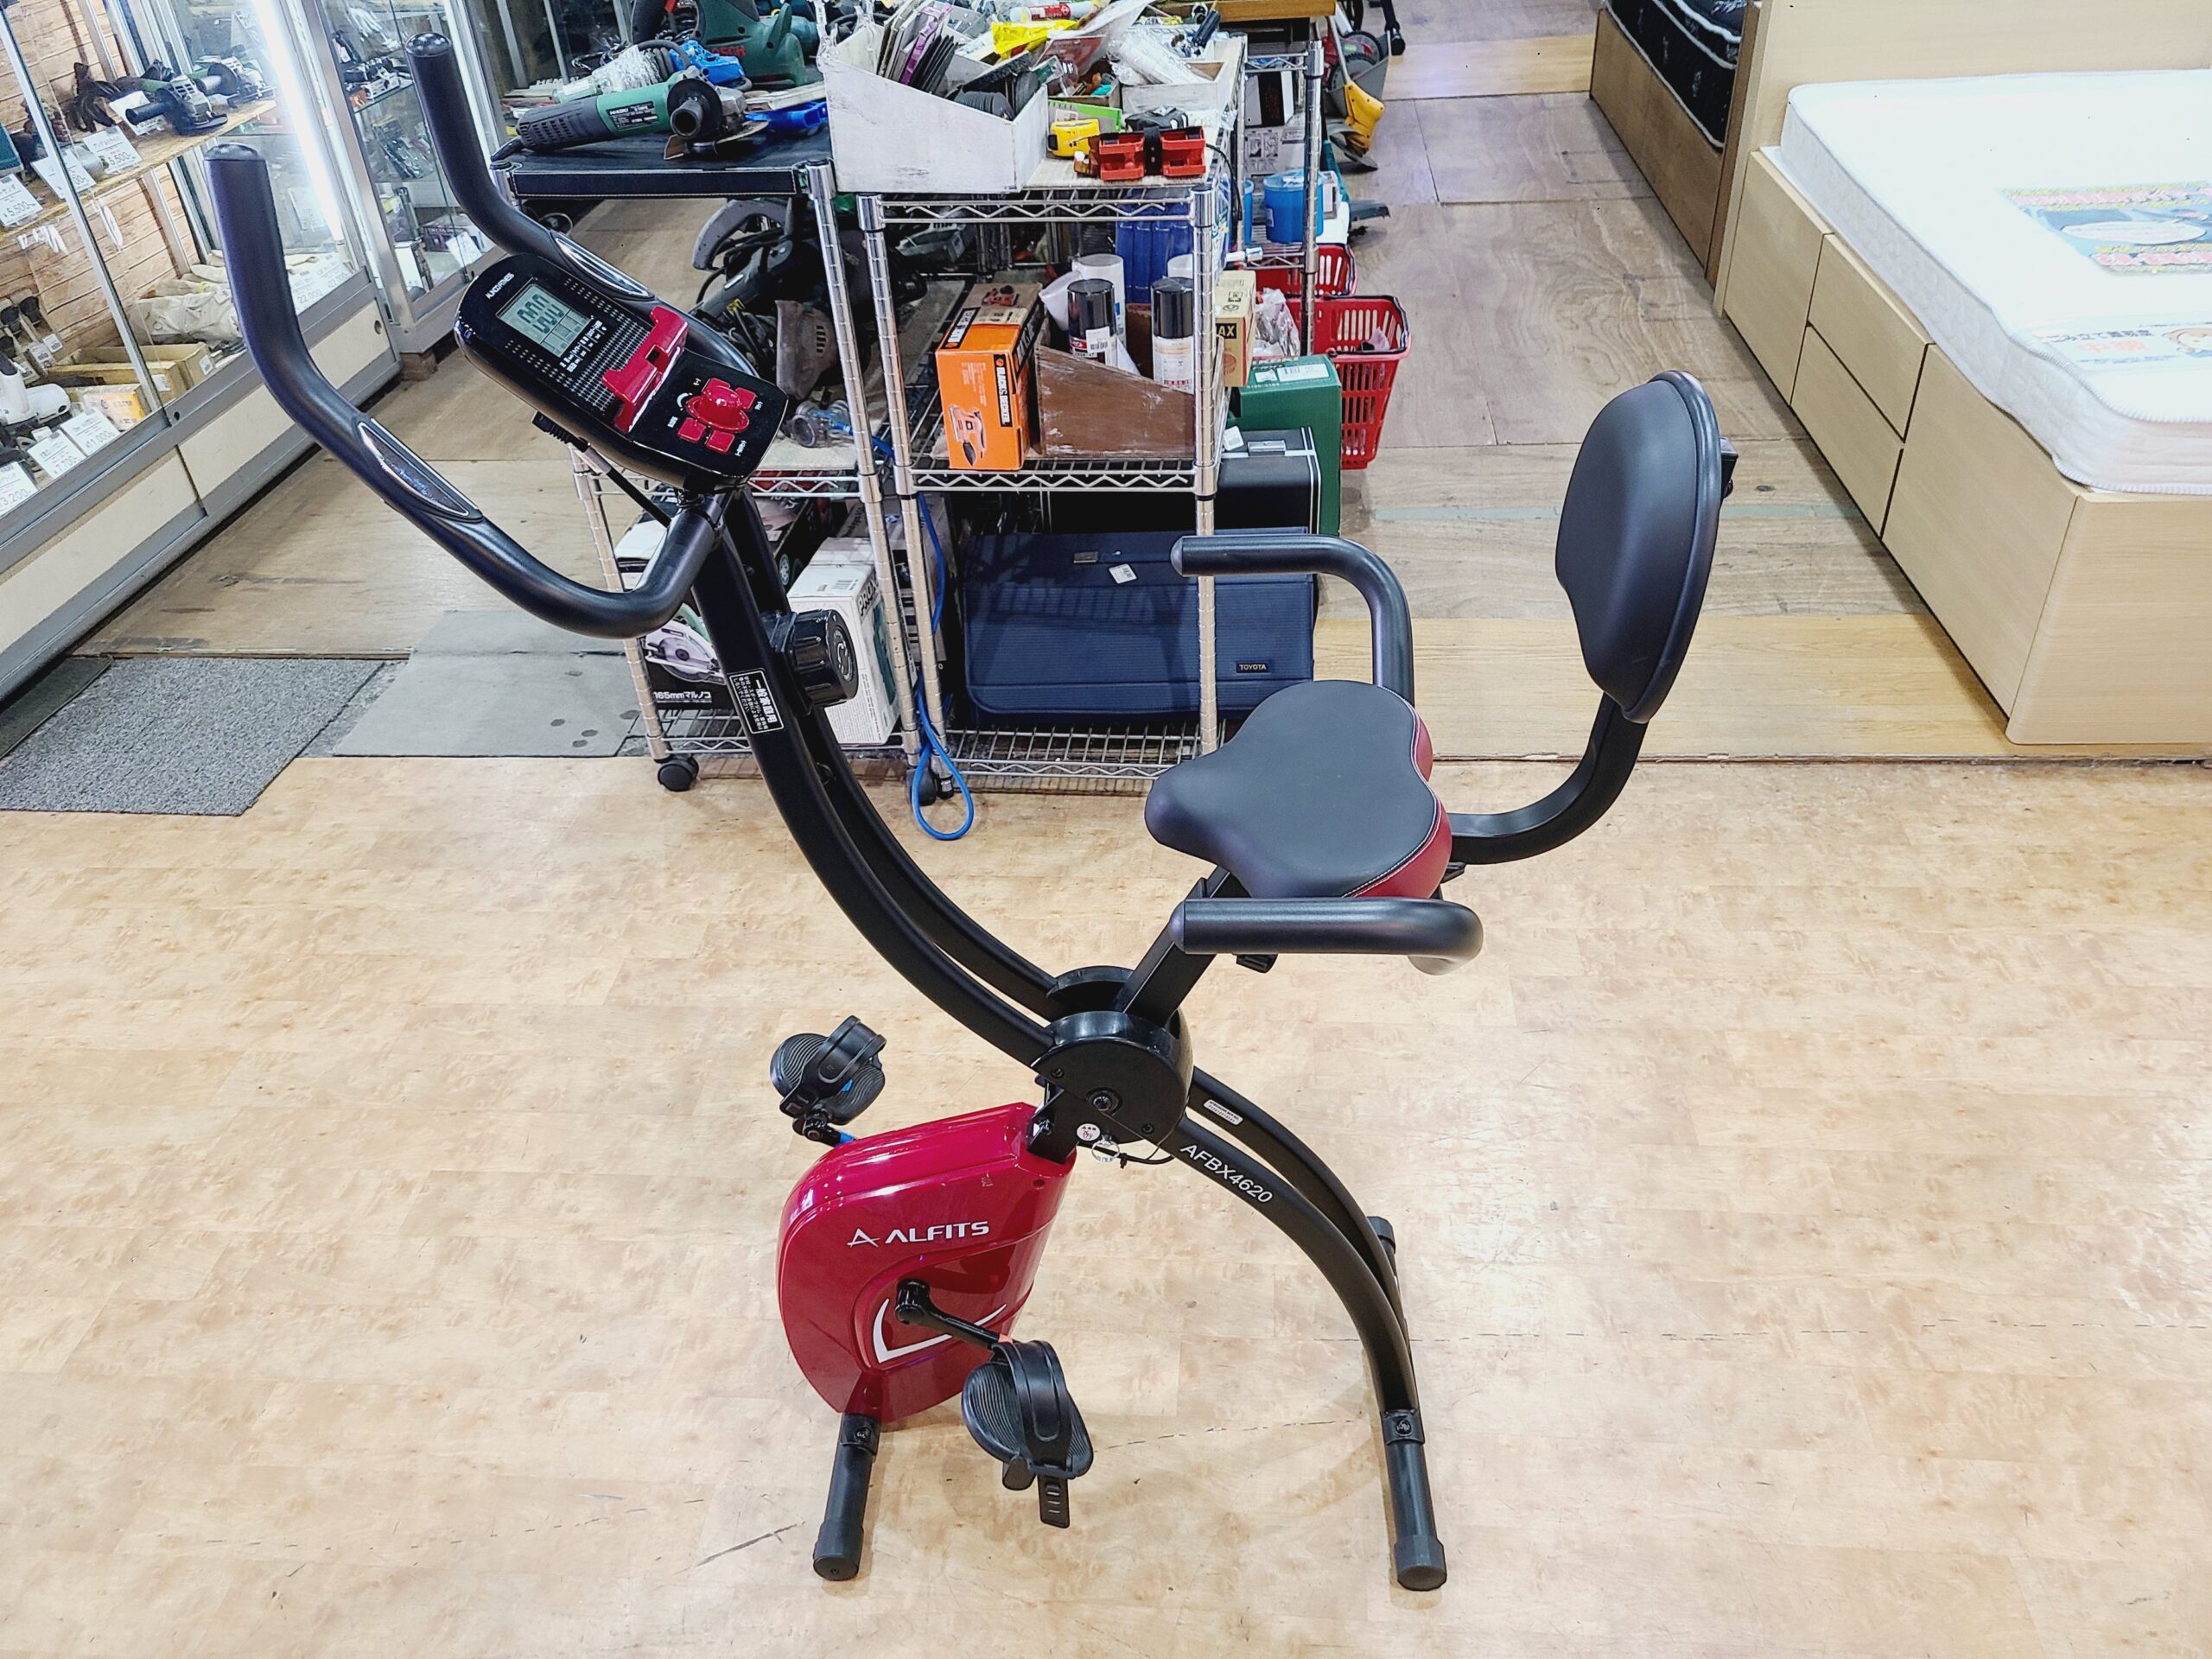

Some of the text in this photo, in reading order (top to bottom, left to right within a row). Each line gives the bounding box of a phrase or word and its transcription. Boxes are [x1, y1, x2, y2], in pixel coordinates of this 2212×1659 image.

[1217, 324, 1236, 337] AX
[755, 679, 778, 723] 一般家庭用
[1180, 1145, 1273, 1203] AFBX4620
[885, 1220, 989, 1244] ALFITS
